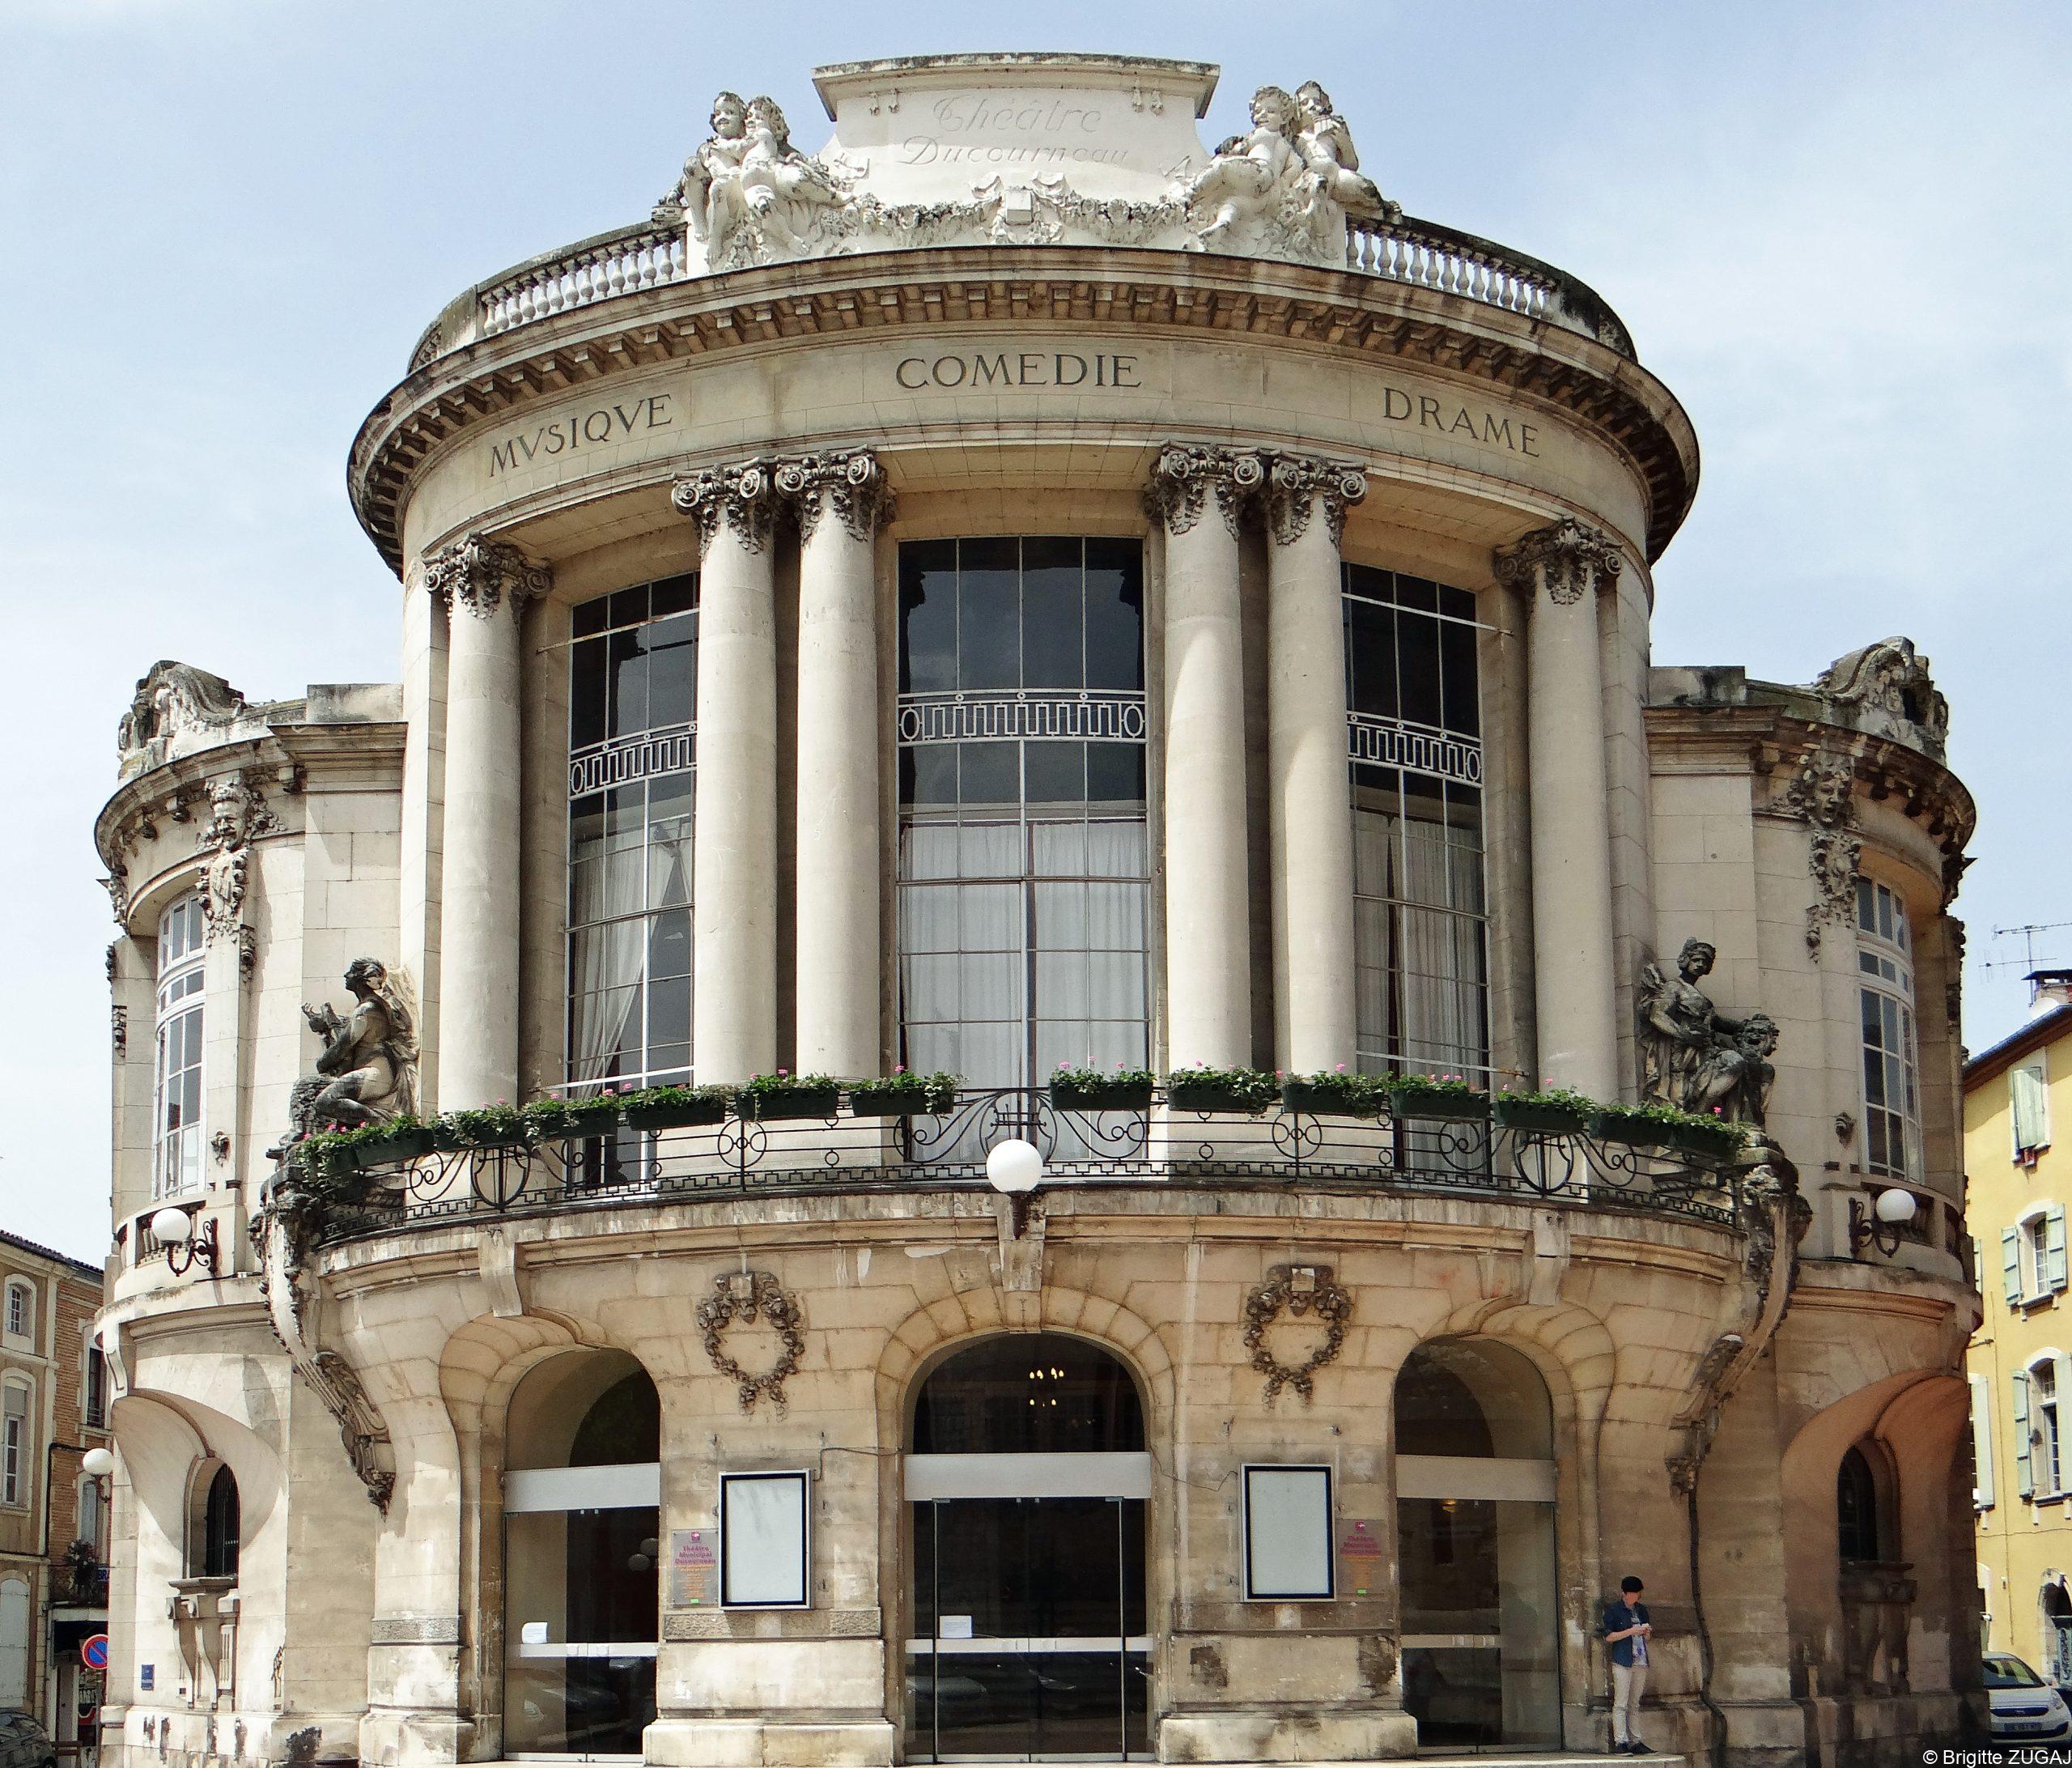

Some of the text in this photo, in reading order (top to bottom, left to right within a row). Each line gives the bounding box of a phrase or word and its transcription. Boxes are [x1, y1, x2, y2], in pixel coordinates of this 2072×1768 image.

[896, 135, 1129, 166] Ducourneau
[895, 352, 1143, 389] COMEDIE
[489, 393, 673, 478] MVSIQVE
[1383, 387, 1540, 457] DRAME
